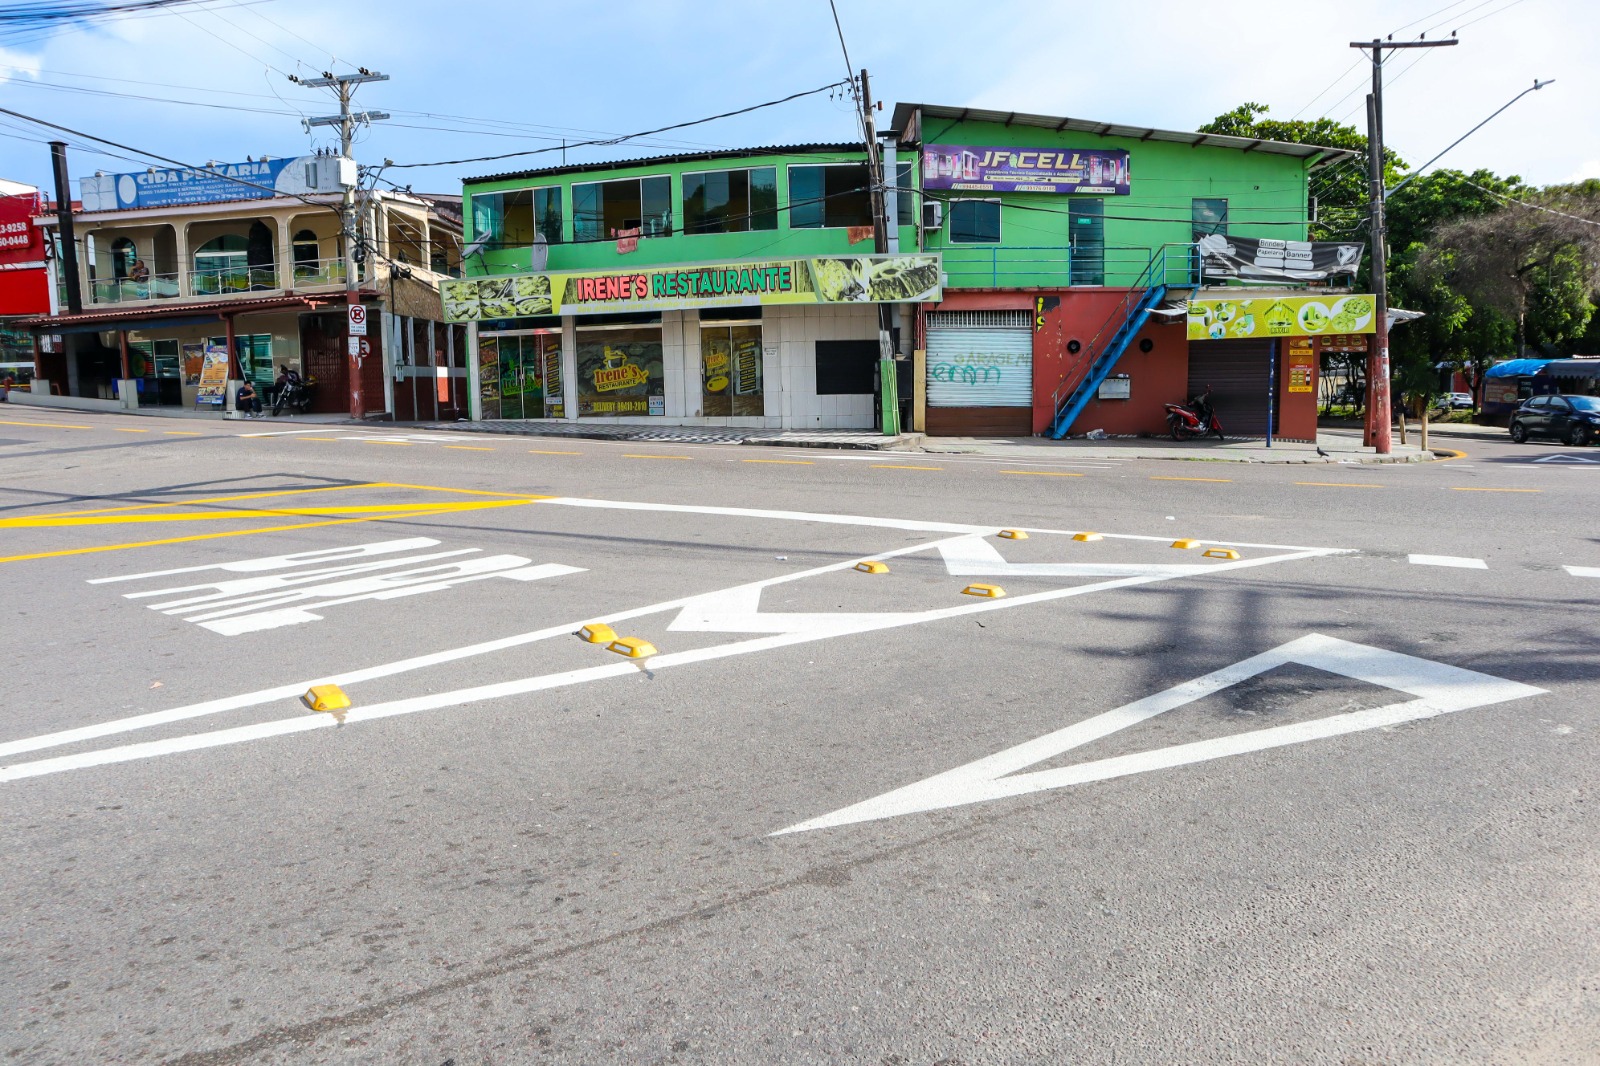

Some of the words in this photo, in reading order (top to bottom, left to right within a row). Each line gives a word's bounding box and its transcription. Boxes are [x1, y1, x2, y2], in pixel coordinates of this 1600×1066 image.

[978, 151, 1010, 168] JF
[1017, 151, 1085, 170] CELL
[137, 170, 178, 185] CIDA
[182, 162, 271, 181] PEIXARIA
[0, 222, 27, 234] 3-9258
[1260, 239, 1285, 248] Brindes
[1286, 250, 1311, 259] Banner
[653, 266, 791, 297] RESTAURANTE
[595, 365, 638, 384] Irene's
[598, 378, 637, 390] RESTAURANTE
